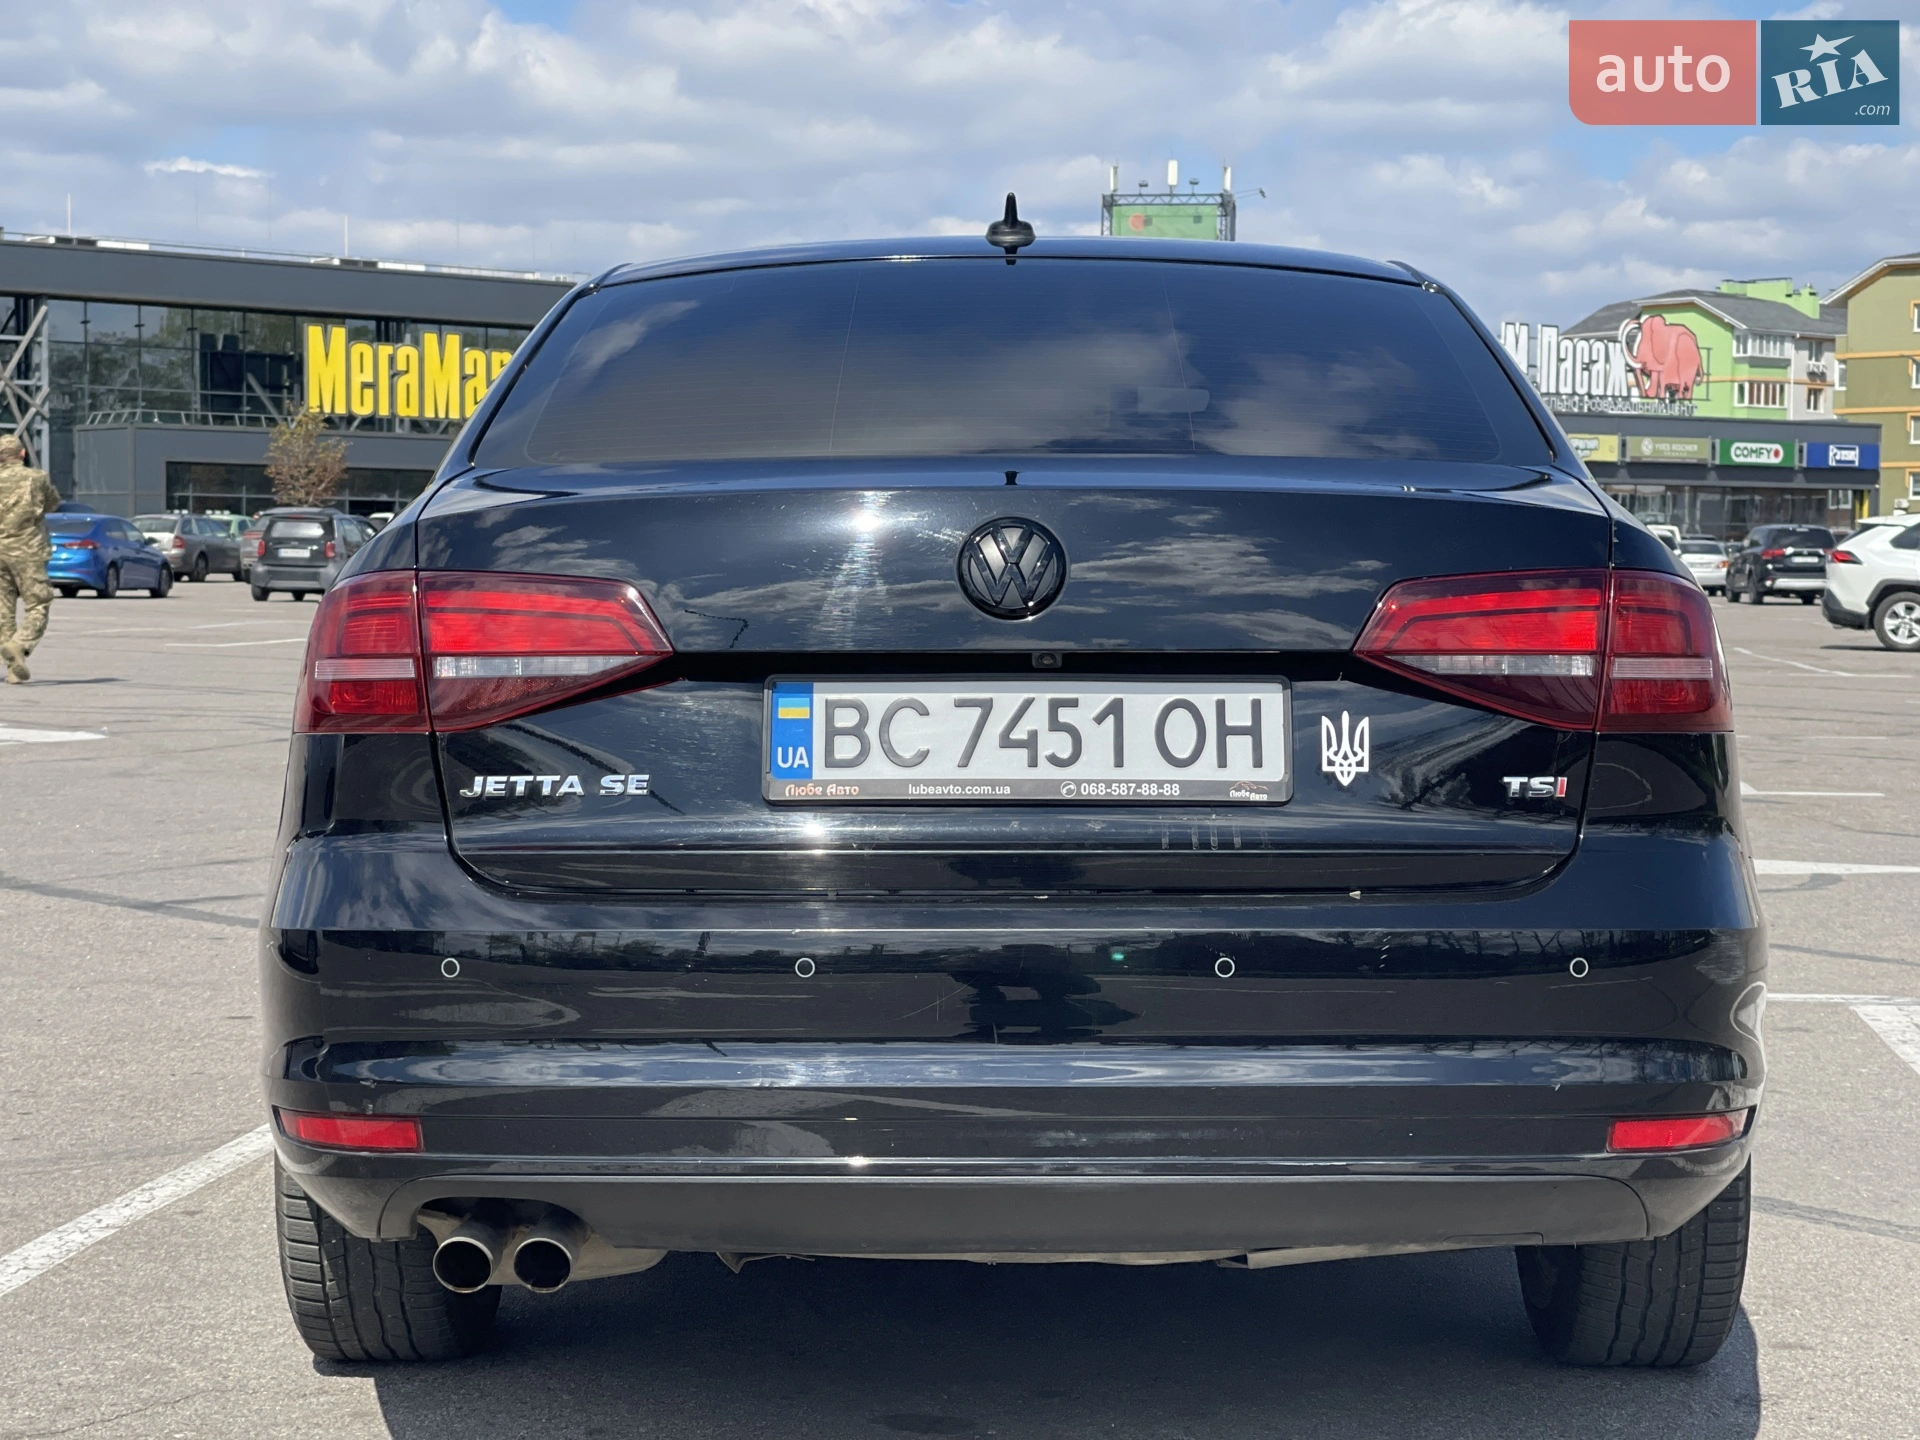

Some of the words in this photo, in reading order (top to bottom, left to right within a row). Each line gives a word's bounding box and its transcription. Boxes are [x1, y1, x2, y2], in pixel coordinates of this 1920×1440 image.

[1733, 446, 1773, 460] COMFY
[825, 696, 931, 769] BC
[954, 696, 1125, 769] 7451
[1154, 696, 1263, 769] OH
[776, 746, 810, 768] UA
[459, 775, 585, 798] JETTA
[600, 775, 650, 797] SE
[785, 783, 822, 797] Любе
[826, 783, 860, 797] Авто
[908, 783, 1011, 796] lubeavto.com.ua
[1080, 782, 1180, 797] 068-587-88-88
